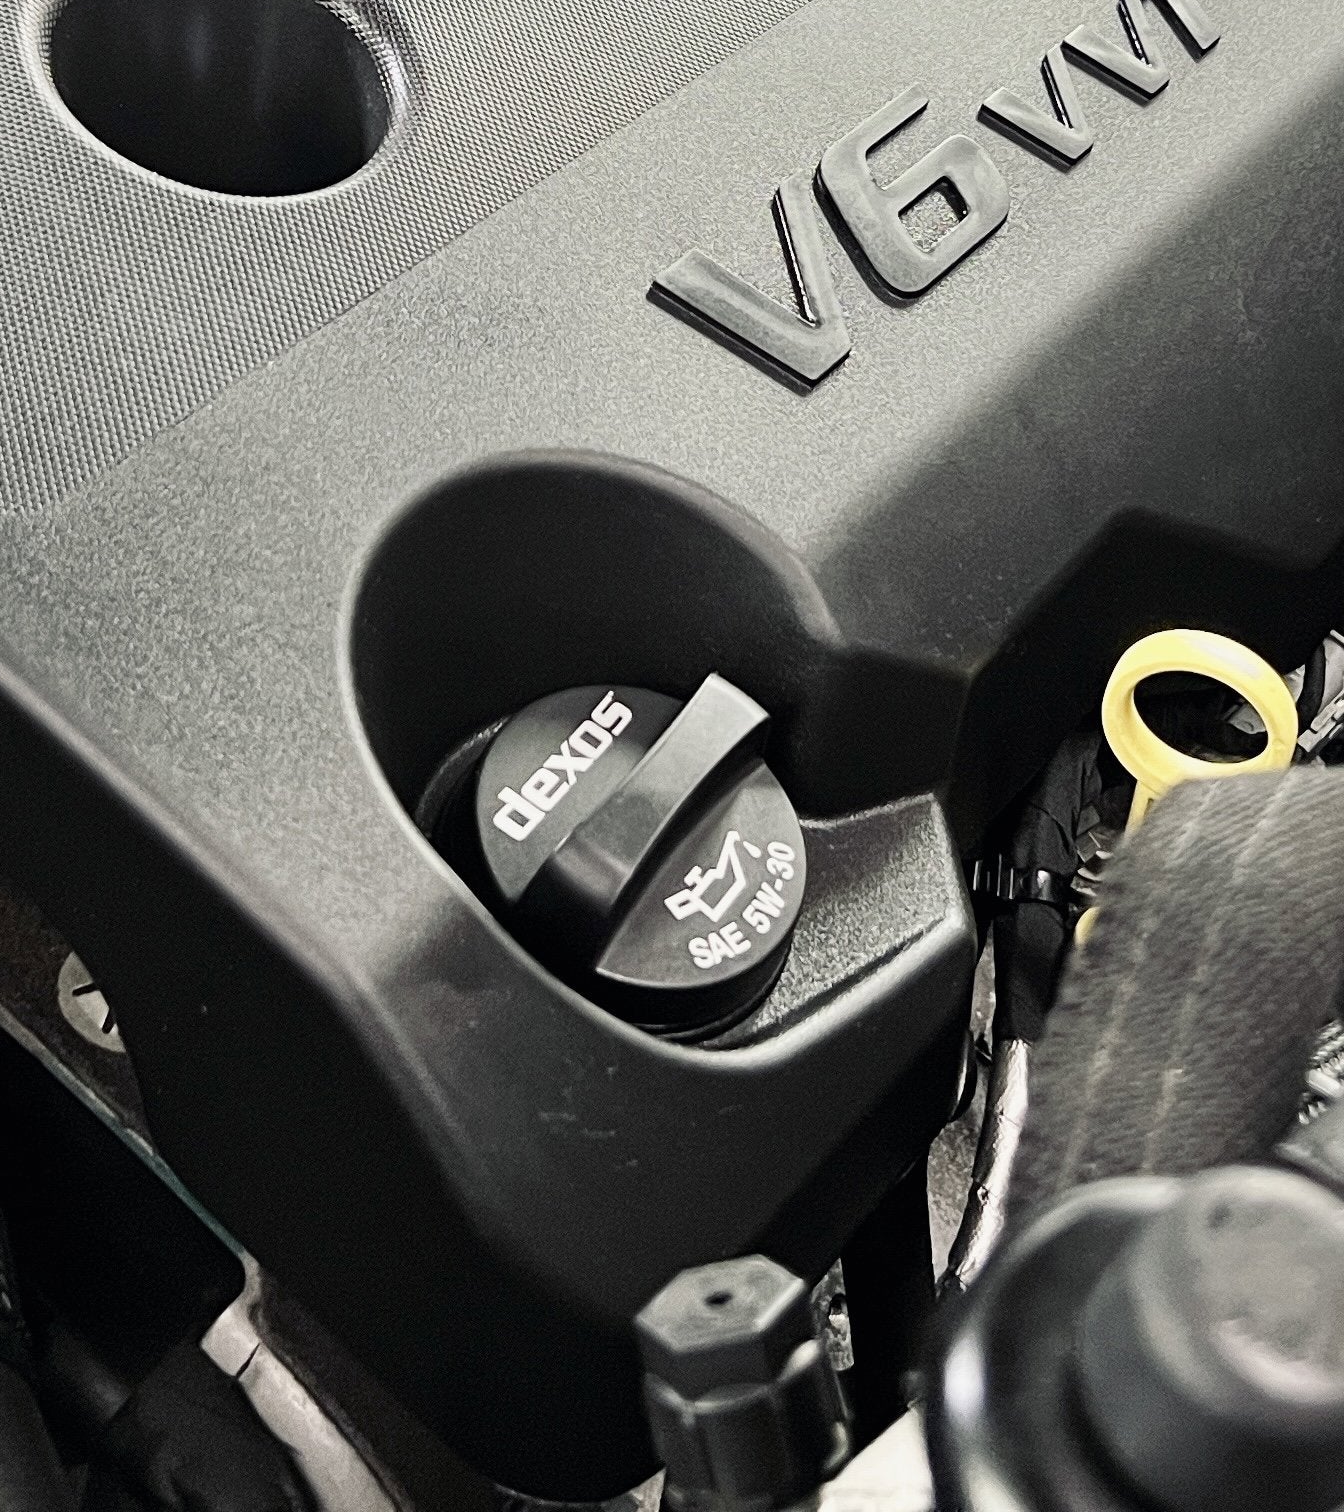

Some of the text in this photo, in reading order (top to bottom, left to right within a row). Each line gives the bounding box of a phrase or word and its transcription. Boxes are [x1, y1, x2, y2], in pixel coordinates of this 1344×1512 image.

[646, 88, 1011, 396] V6
[492, 690, 633, 842] dexos
[688, 841, 795, 969] SAE 5W-30
